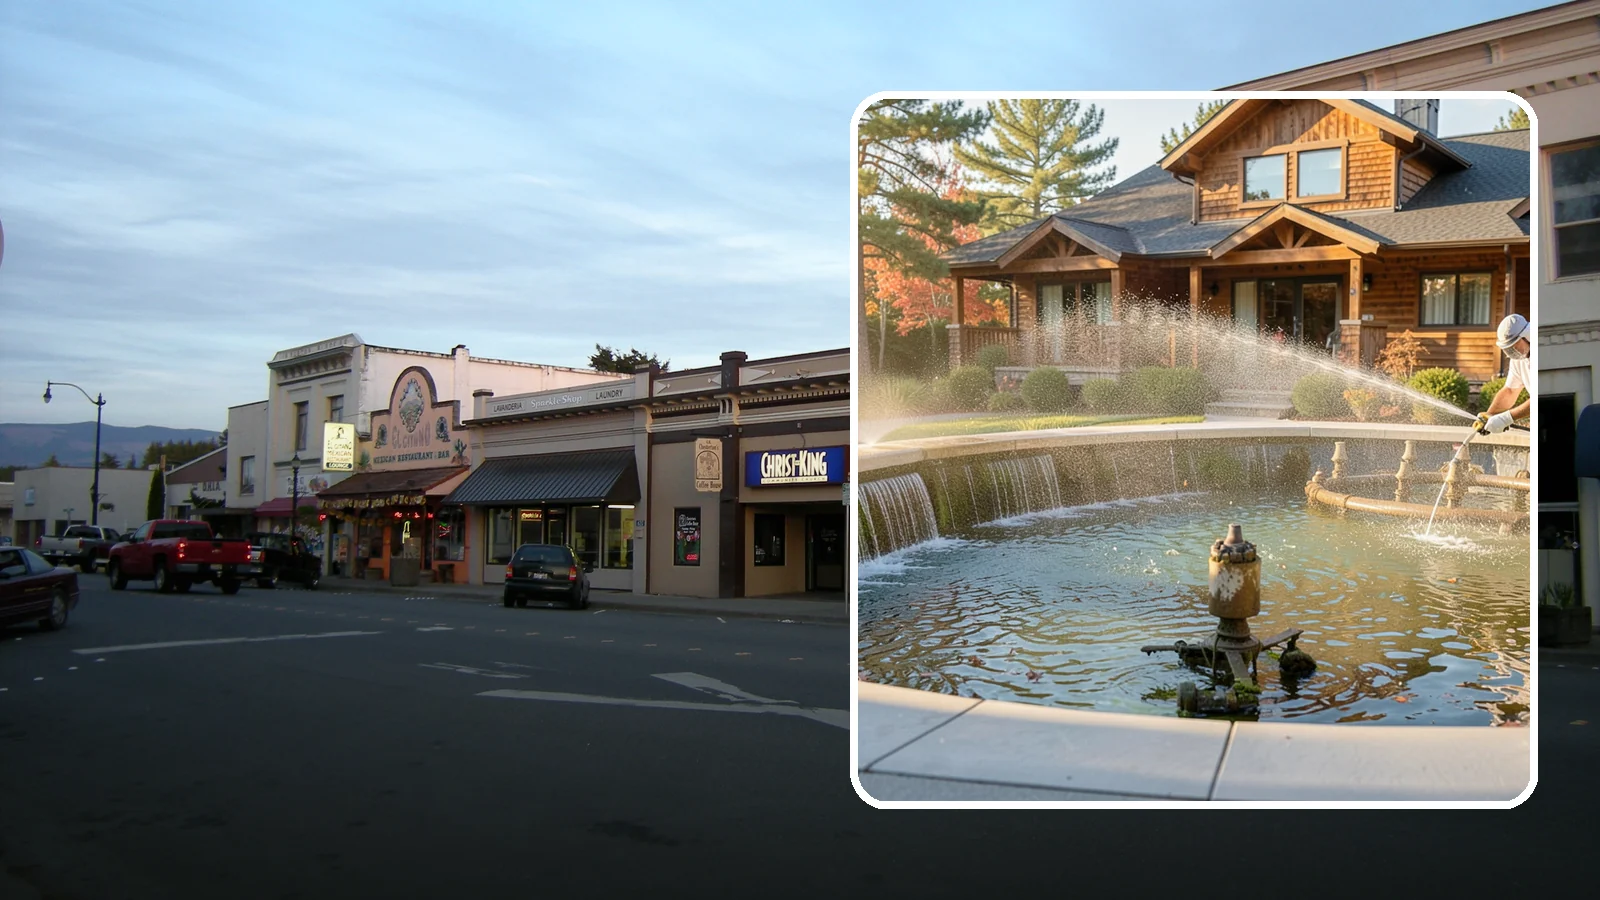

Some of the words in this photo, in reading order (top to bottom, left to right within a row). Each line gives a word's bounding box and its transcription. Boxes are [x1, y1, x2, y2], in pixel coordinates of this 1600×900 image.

[493, 402, 522, 412] LAVANDERIA
[531, 397, 560, 408] Sparkle
[561, 394, 582, 404] Shop
[595, 389, 623, 400] LAUNDRY
[373, 455, 396, 464] MEXICAN
[397, 451, 433, 462] RESTAURANT
[437, 450, 450, 459] BAR
